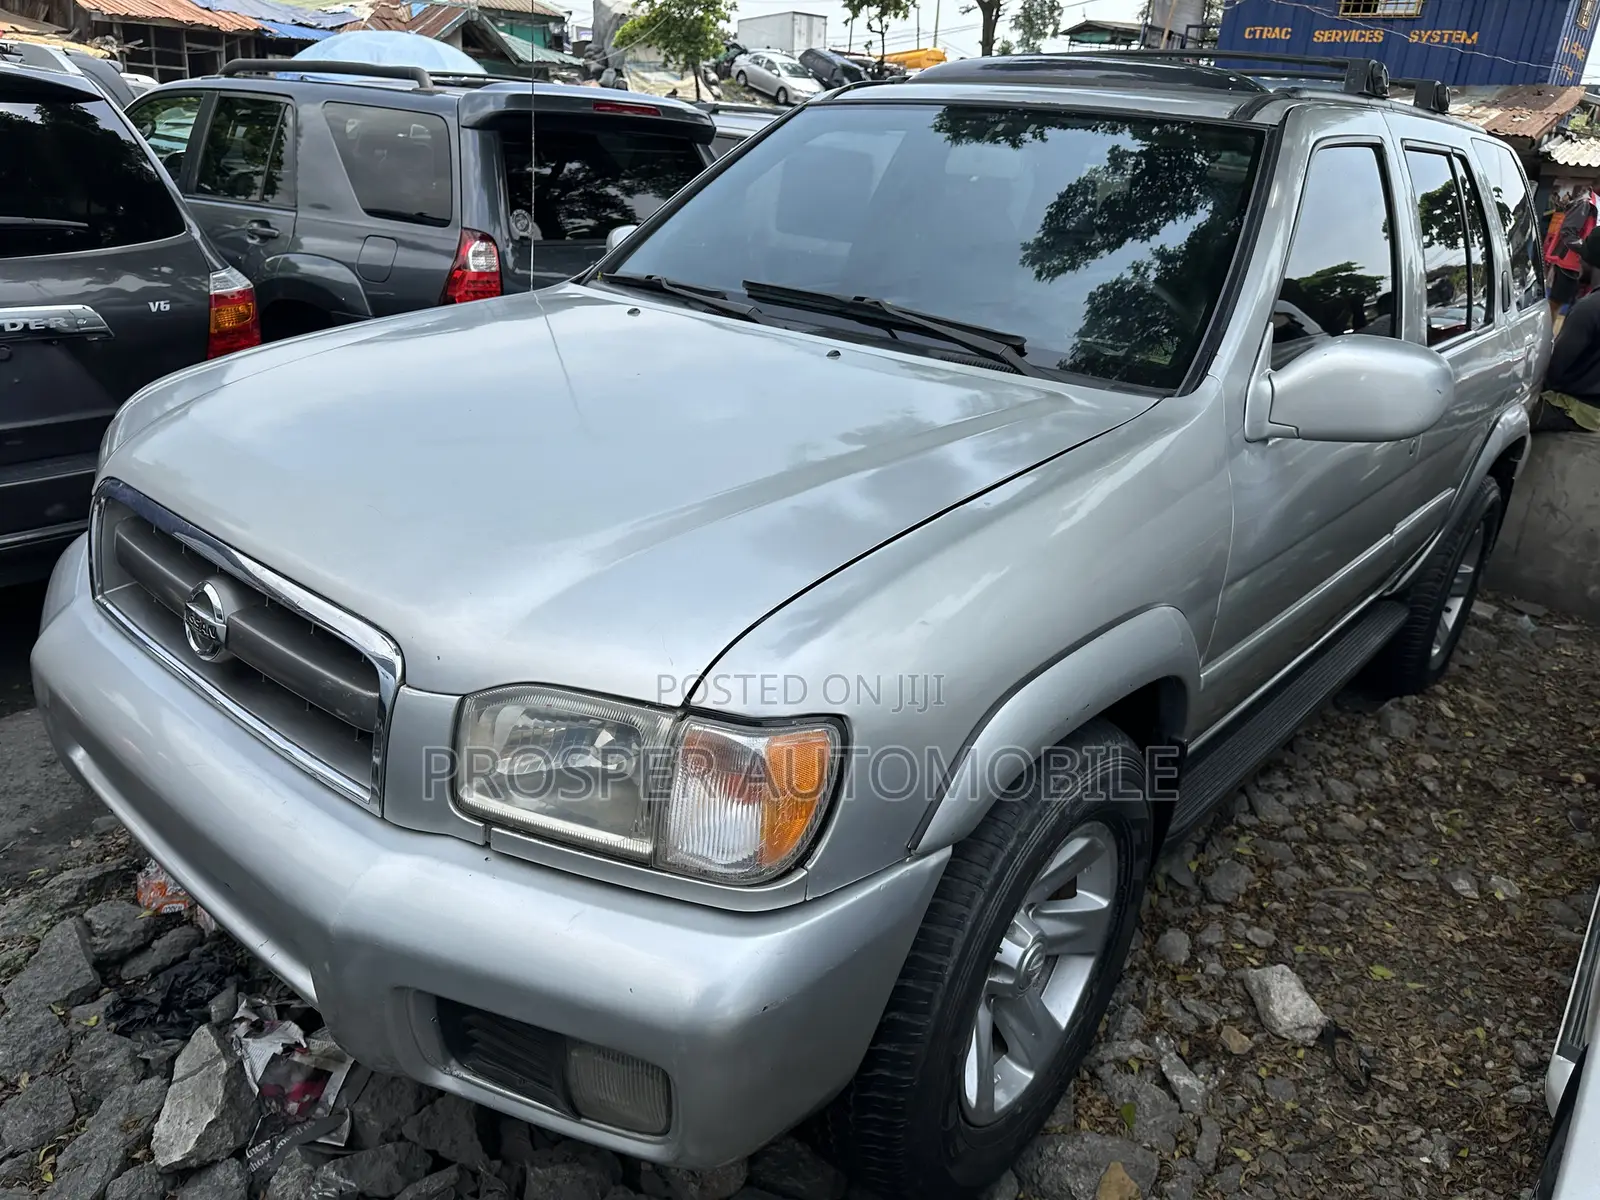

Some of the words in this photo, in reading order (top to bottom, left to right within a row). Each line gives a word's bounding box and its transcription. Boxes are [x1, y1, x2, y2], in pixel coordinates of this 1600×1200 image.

[1244, 27, 1292, 40] CTRAC
[1312, 29, 1384, 43] SERVICES
[1408, 30, 1479, 45] SYSTEM
[148, 300, 170, 312] V6
